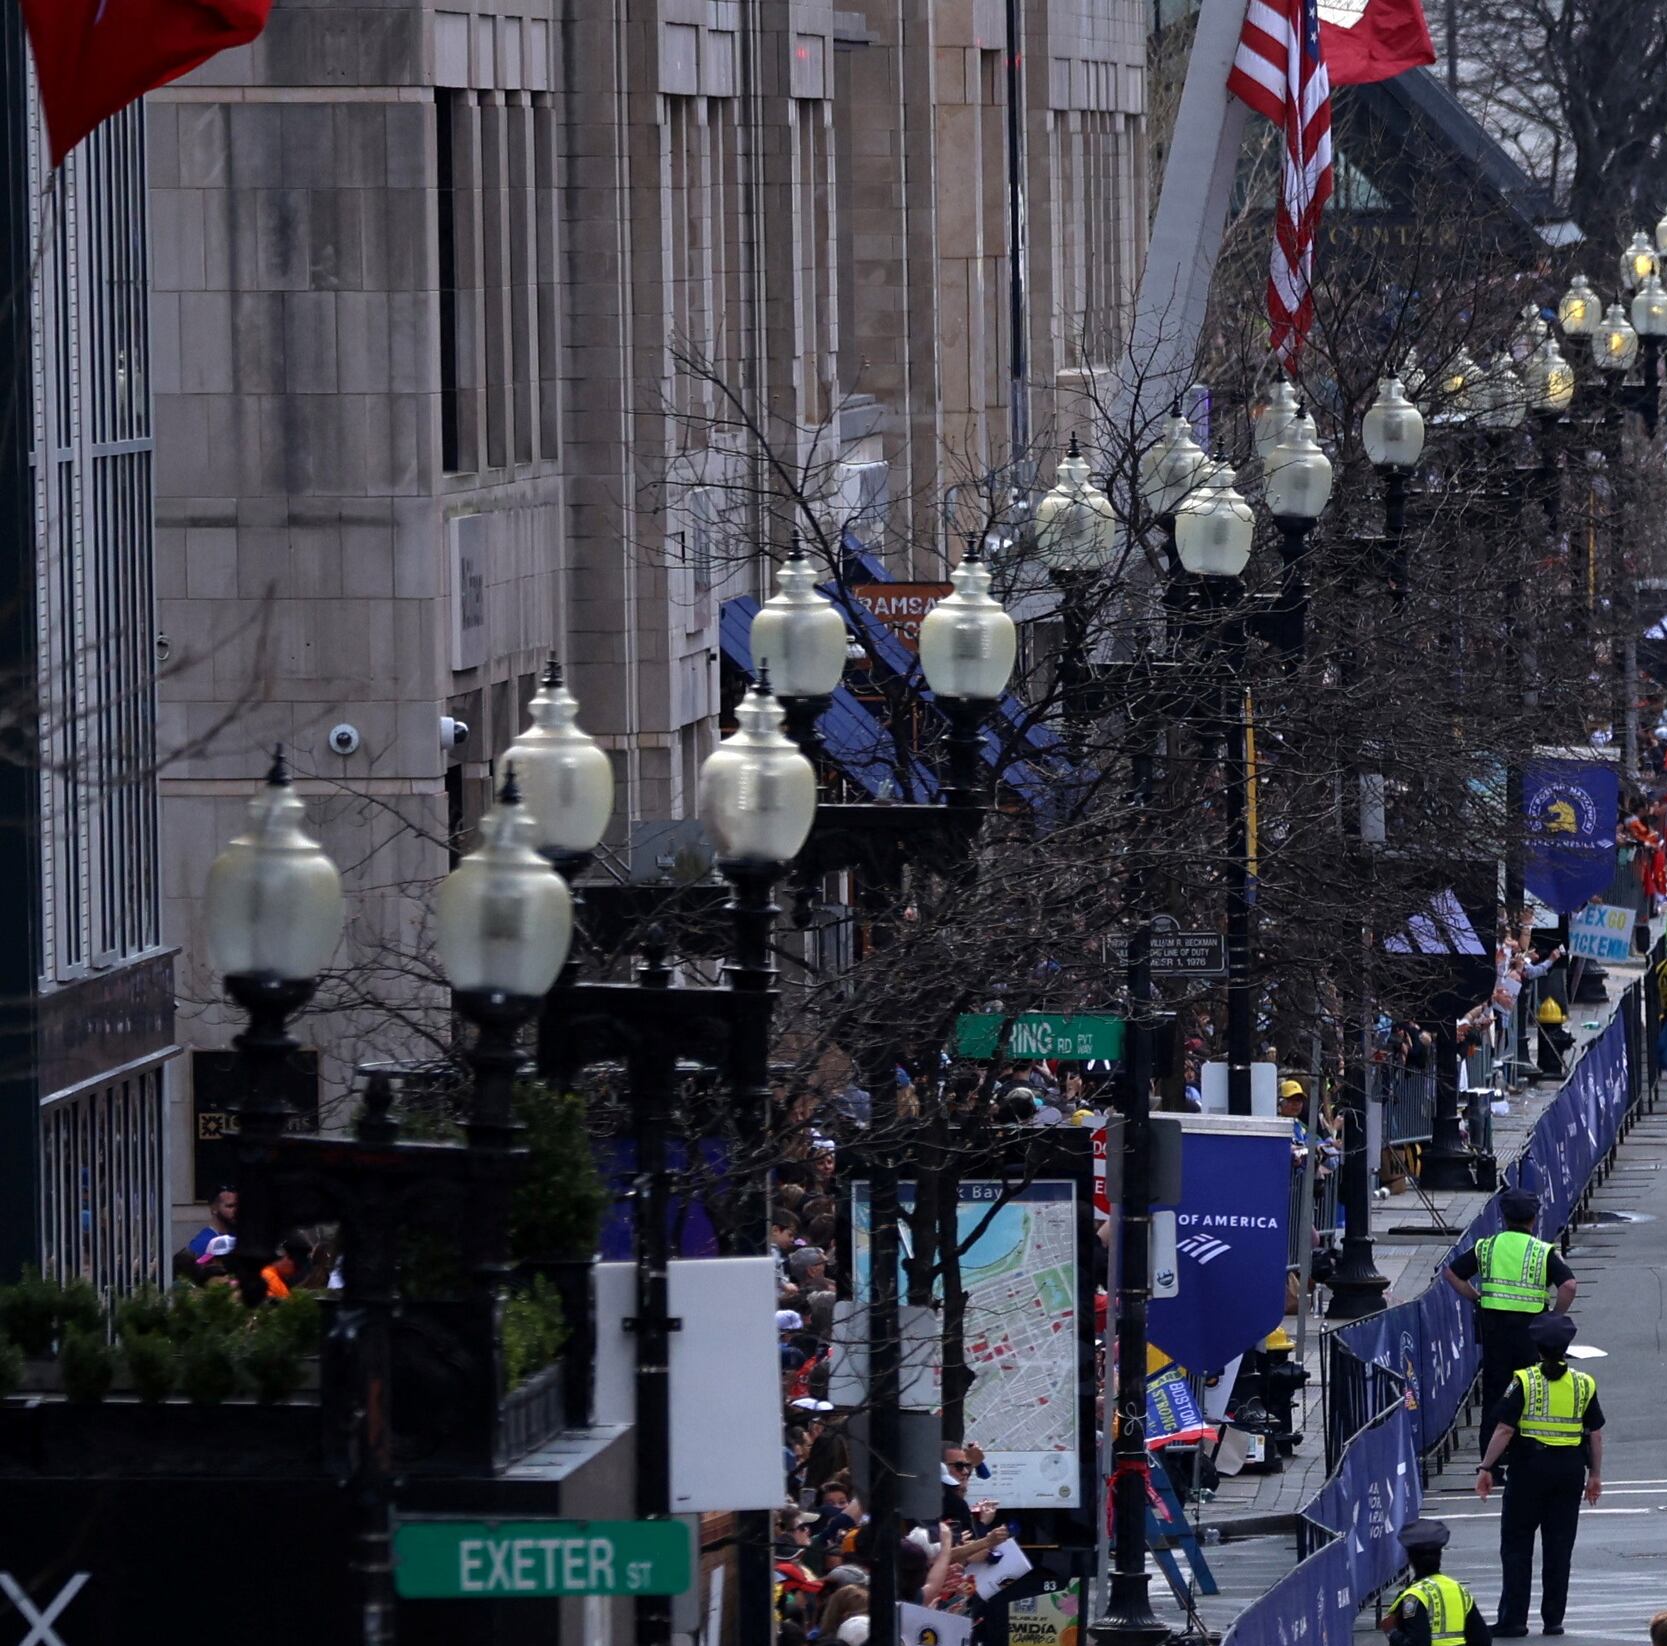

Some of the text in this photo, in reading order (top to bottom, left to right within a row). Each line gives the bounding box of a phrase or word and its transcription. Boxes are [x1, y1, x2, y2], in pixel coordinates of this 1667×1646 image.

[859, 597, 942, 615] RAMSA
[1180, 949, 1189, 957] OF
[1191, 948, 1209, 956] DUTY
[1058, 1037, 1072, 1053] RD
[972, 1185, 1004, 1199] Bay
[1178, 1214, 1279, 1230] OF AMERICA
[1152, 1389, 1179, 1432] STRONG
[1169, 1381, 1199, 1426] BOSTON
[459, 1539, 651, 1591] EXETER ST
[1043, 1581, 1057, 1591] 83
